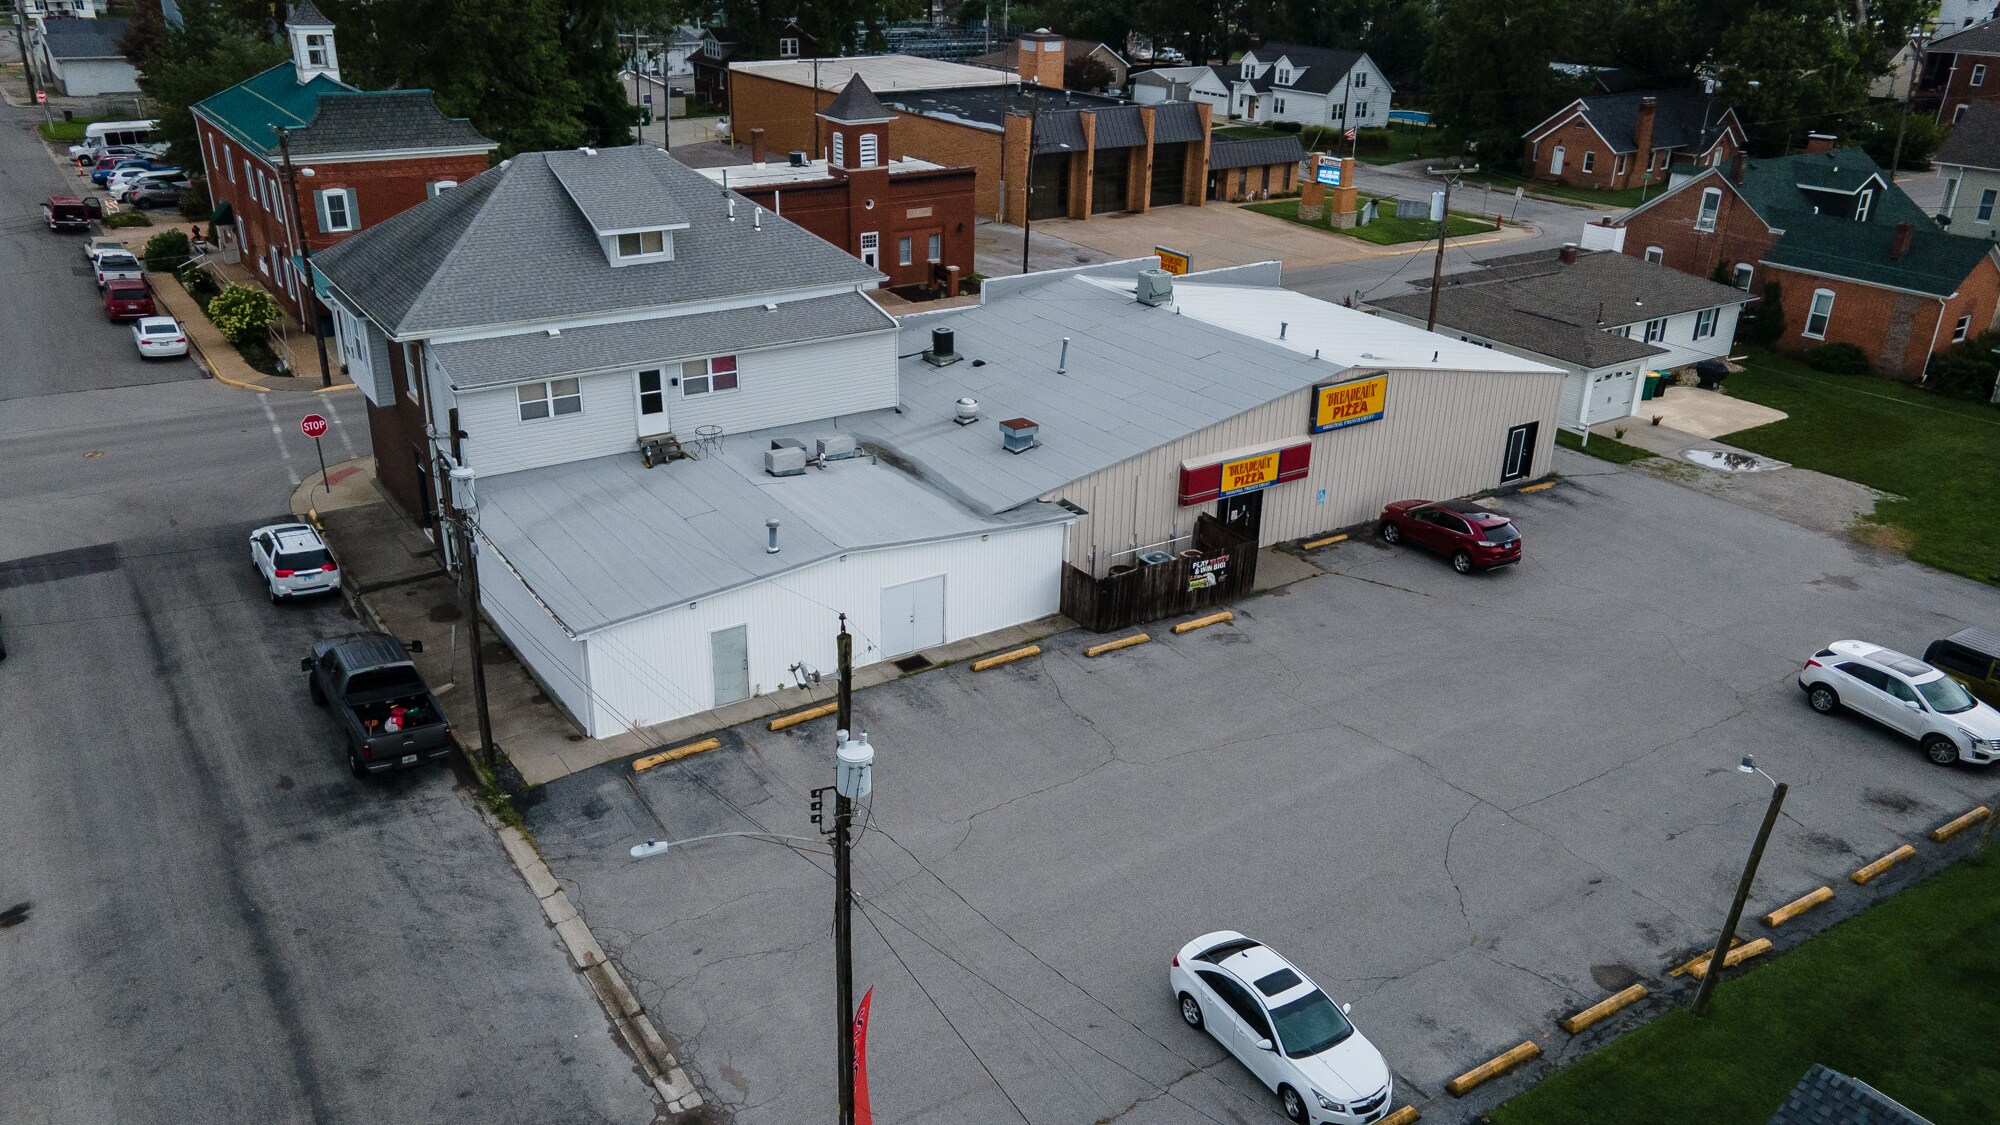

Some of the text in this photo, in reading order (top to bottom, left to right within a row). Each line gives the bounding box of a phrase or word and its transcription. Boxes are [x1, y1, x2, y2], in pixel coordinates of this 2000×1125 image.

[1332, 401, 1368, 419] PIZZA
[303, 420, 325, 431] STOP
[1343, 417, 1361, 425] FRENCH
[1234, 472, 1265, 487] PIZZA
[1192, 560, 1209, 569] PLAY
[1200, 564, 1213, 573] WIN
[1213, 561, 1226, 570] BIG!
